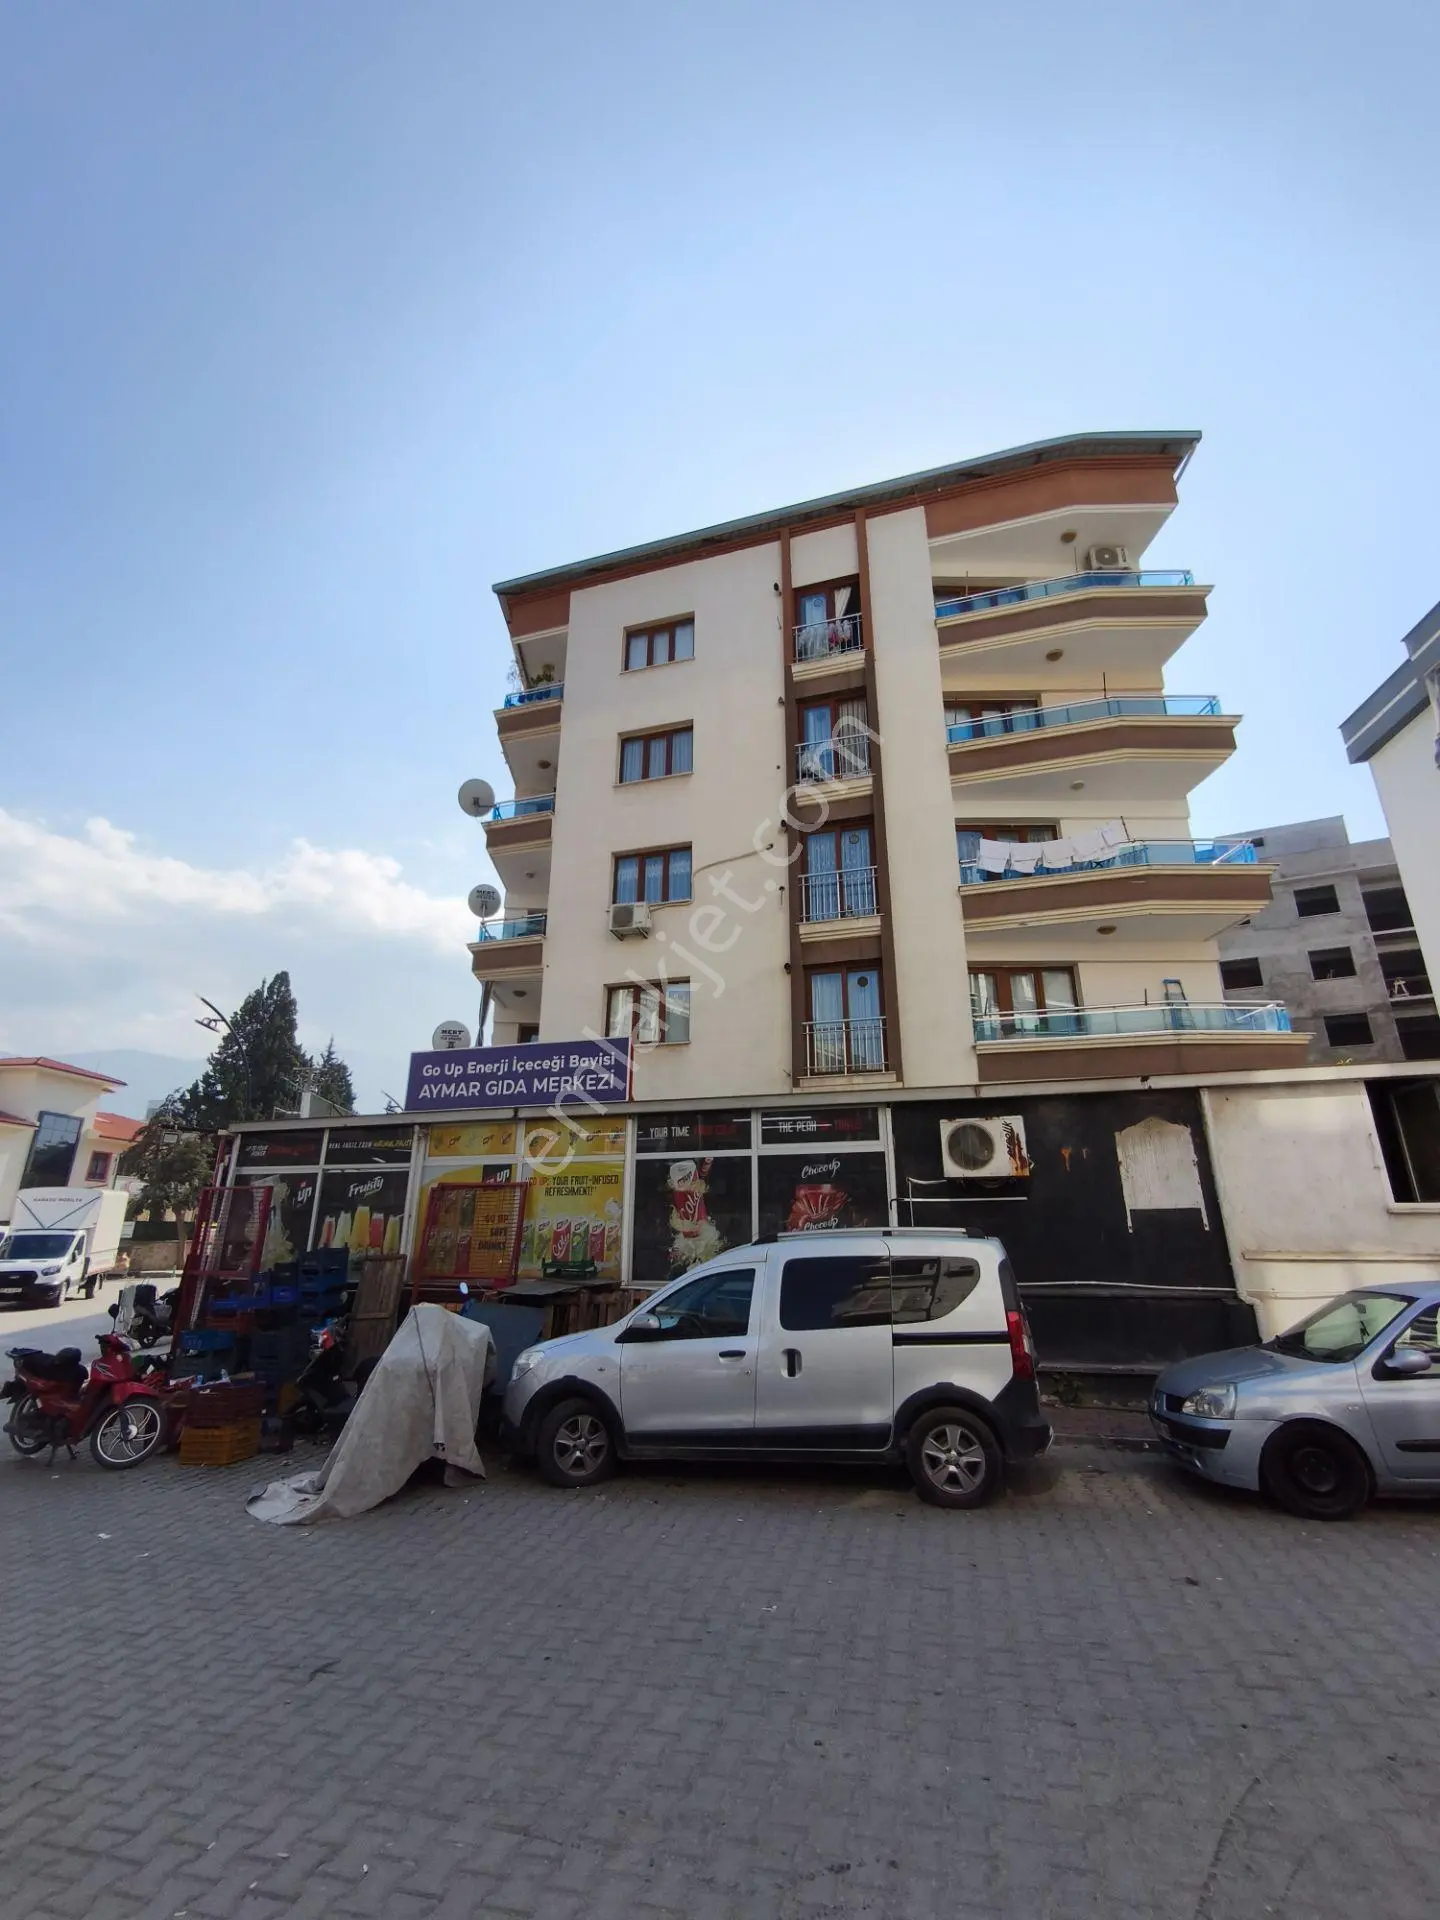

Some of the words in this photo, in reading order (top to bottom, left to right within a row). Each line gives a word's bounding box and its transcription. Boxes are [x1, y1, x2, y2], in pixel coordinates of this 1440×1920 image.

[422, 1064, 441, 1076] Go
[444, 1063, 463, 1077] Up
[467, 1059, 509, 1075] Enerji
[512, 1055, 565, 1073] İçeceği
[569, 1052, 615, 1069] Bayisi
[418, 1081, 481, 1099] AYMAR
[485, 1079, 527, 1096] GIDA
[533, 1069, 615, 1093] MERKEZİ
[650, 1127, 668, 1139] YOUR
[671, 1126, 690, 1137] TIME
[779, 1121, 794, 1133] THE
[552, 1176, 569, 1185] YOUR
[571, 1174, 619, 1185] FRUIT-INFUSED
